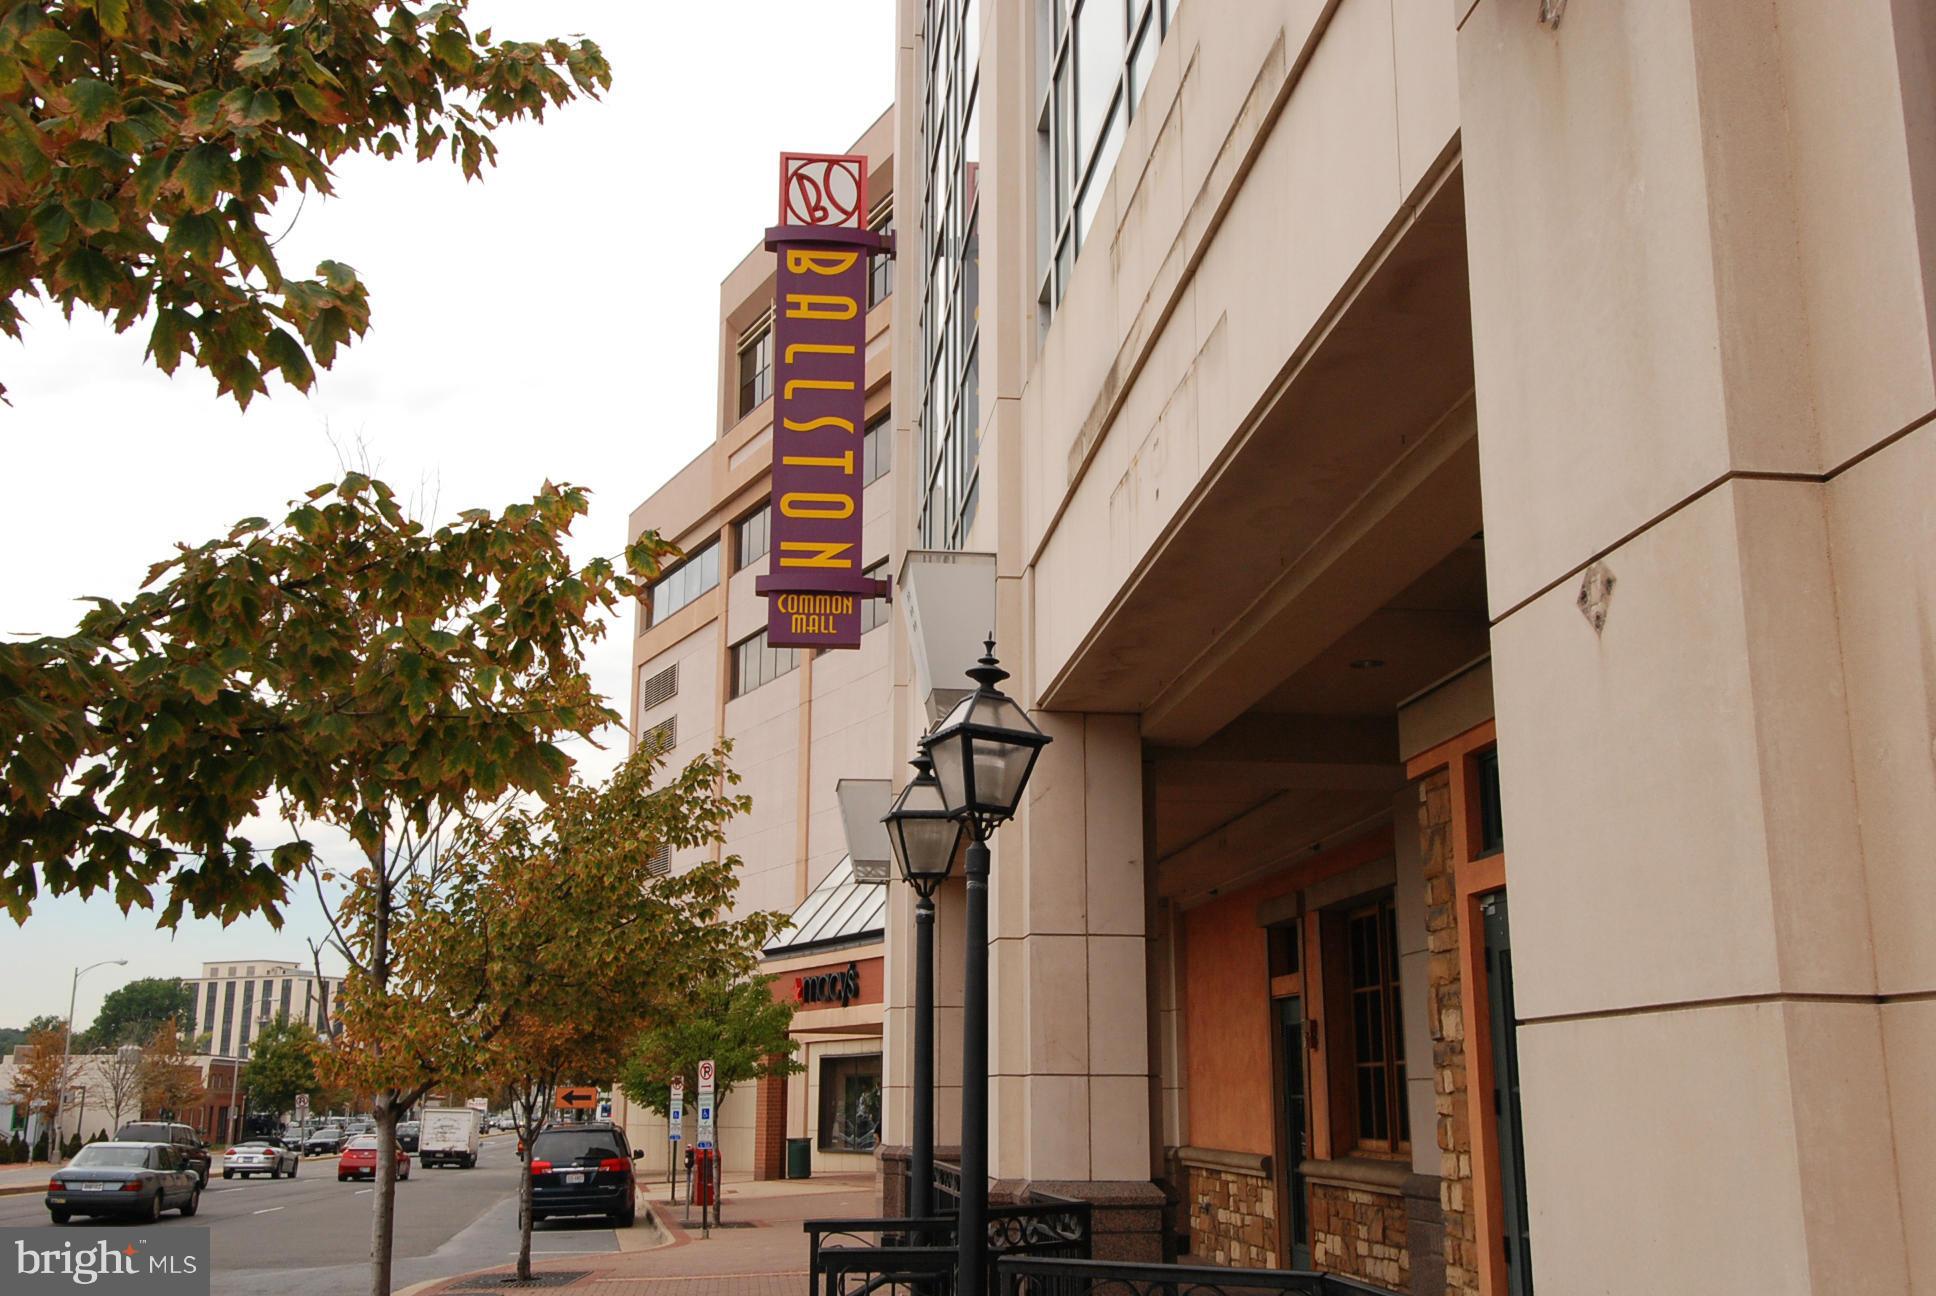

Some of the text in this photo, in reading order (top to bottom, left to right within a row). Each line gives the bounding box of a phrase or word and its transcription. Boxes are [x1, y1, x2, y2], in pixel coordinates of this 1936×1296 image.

[780, 249, 859, 569] BALLSTON
[777, 594, 853, 615] COMMON
[791, 614, 837, 634] MALL
